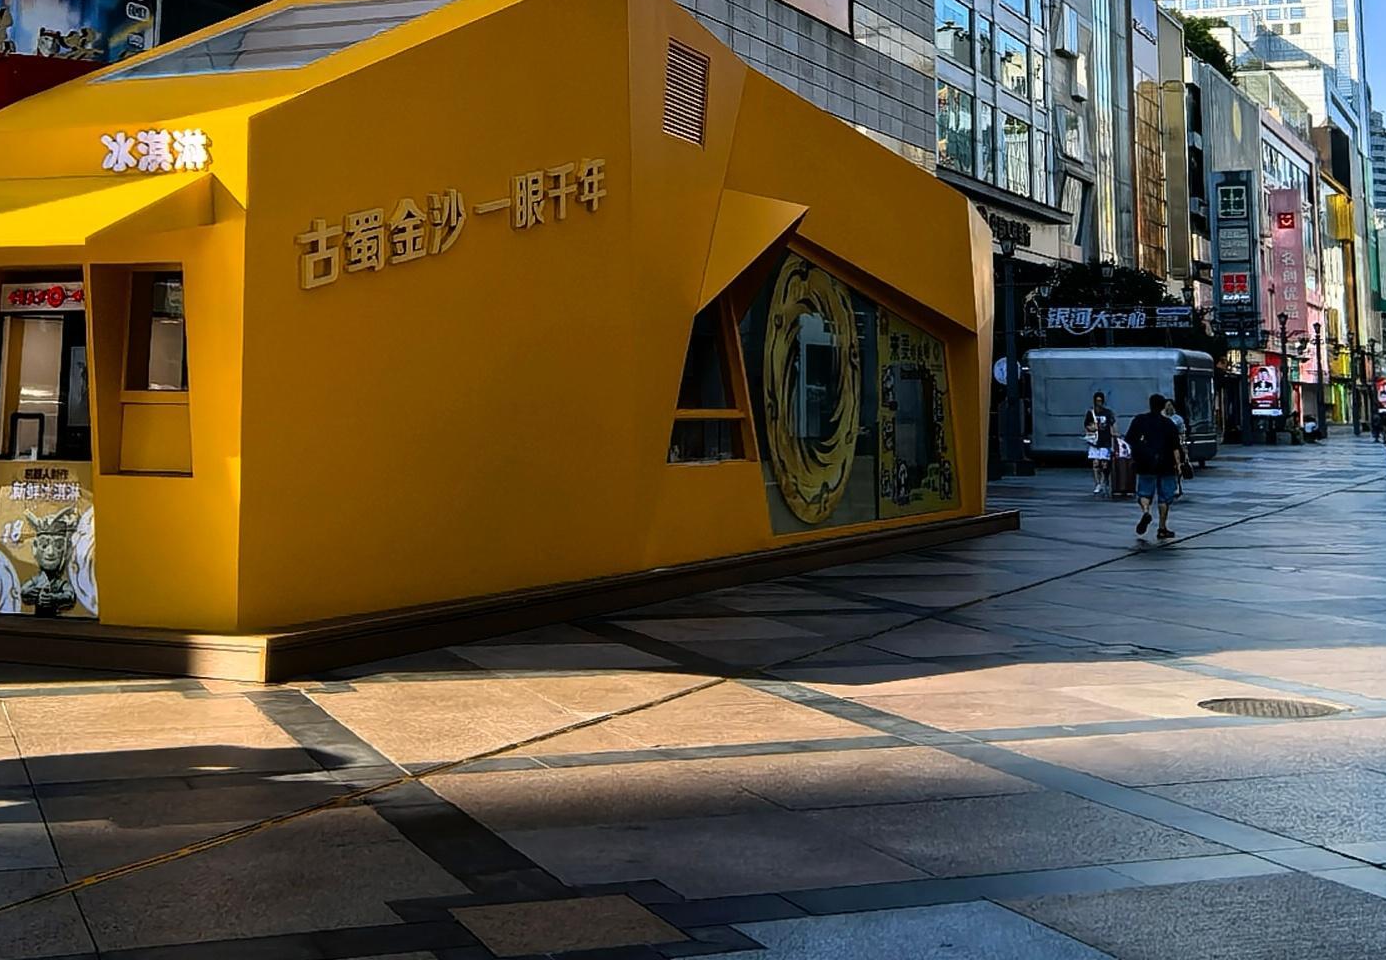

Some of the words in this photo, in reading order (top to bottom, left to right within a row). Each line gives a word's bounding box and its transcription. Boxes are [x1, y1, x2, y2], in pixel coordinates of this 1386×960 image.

[100, 128, 209, 172] 冰淇淋
[295, 188, 468, 290] 古蜀金沙
[474, 158, 607, 230] 一眼千年
[1047, 307, 1147, 335] 银河太空舱
